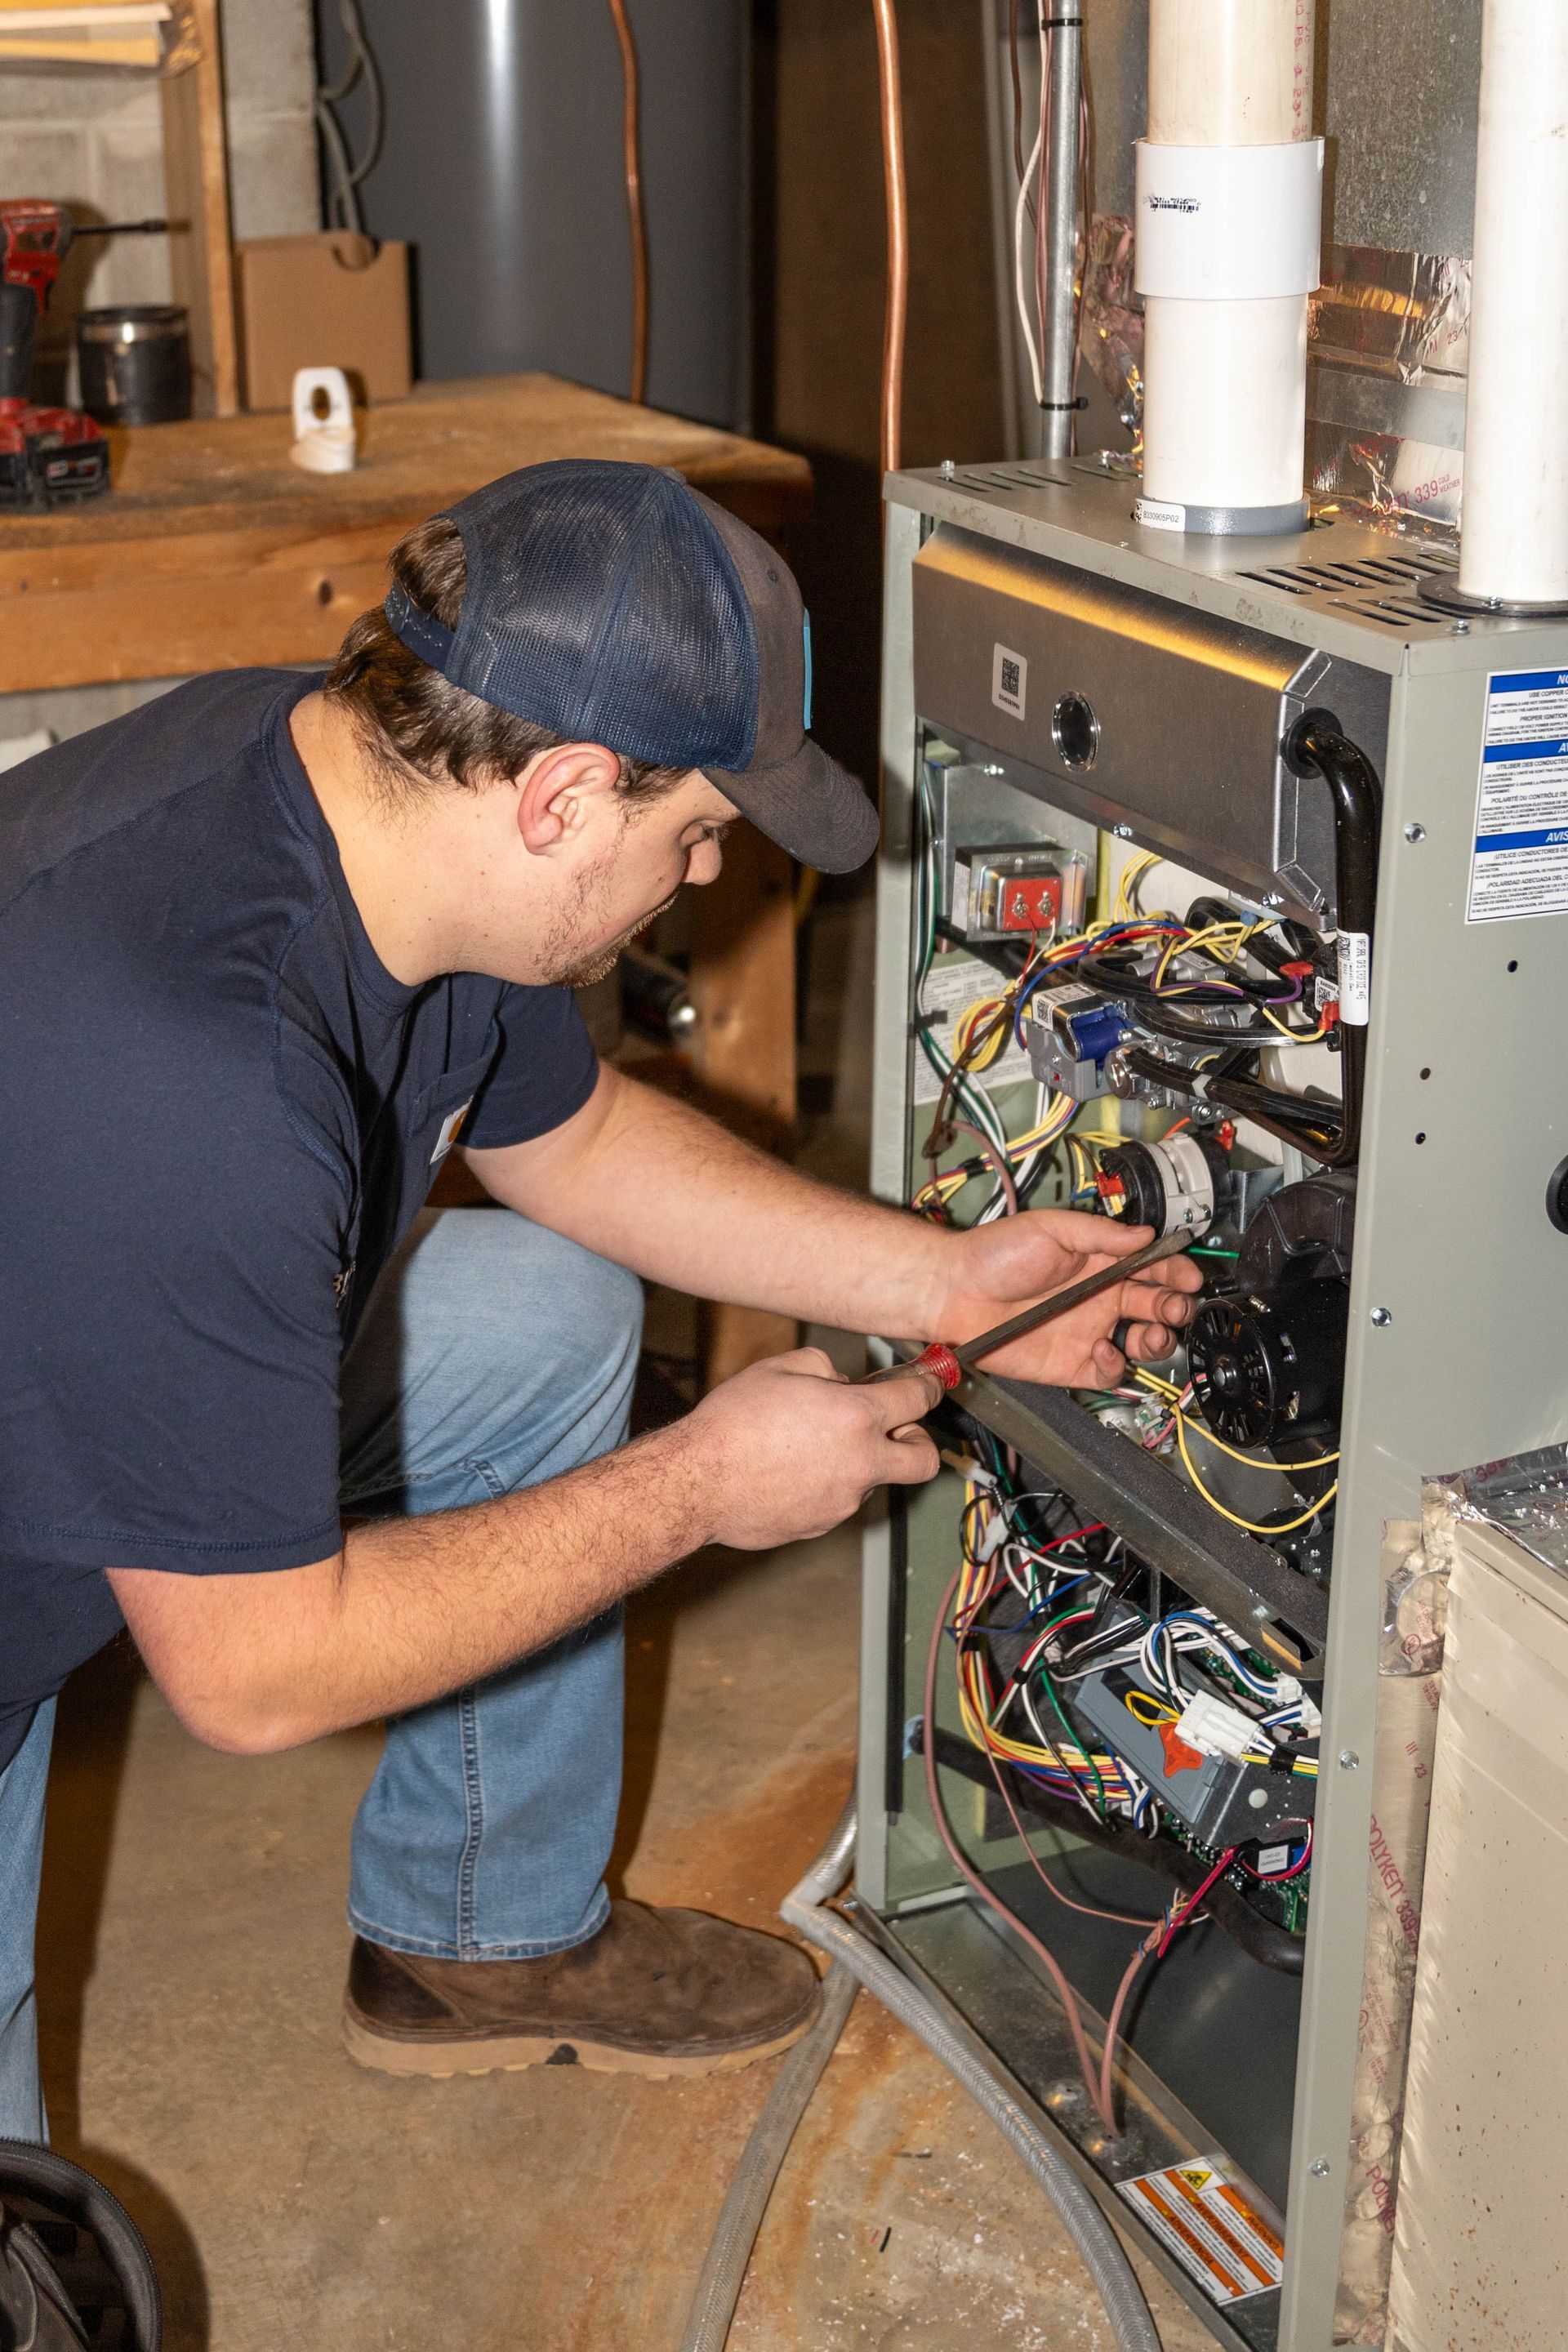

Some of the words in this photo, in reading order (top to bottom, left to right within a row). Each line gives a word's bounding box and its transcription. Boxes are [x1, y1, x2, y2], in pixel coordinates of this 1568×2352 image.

[1414, 480, 1438, 504] 339
[1438, 474, 1450, 485] COLD
[1439, 479, 1460, 492] WEATHER
[1529, 791, 1558, 800] CONTRÔLE
[1518, 848, 1559, 857] CONDUCTORES
[1521, 876, 1551, 884] ADECUADA
[1414, 1762, 1428, 1779] 23
[1396, 1900, 1417, 1932] 339
